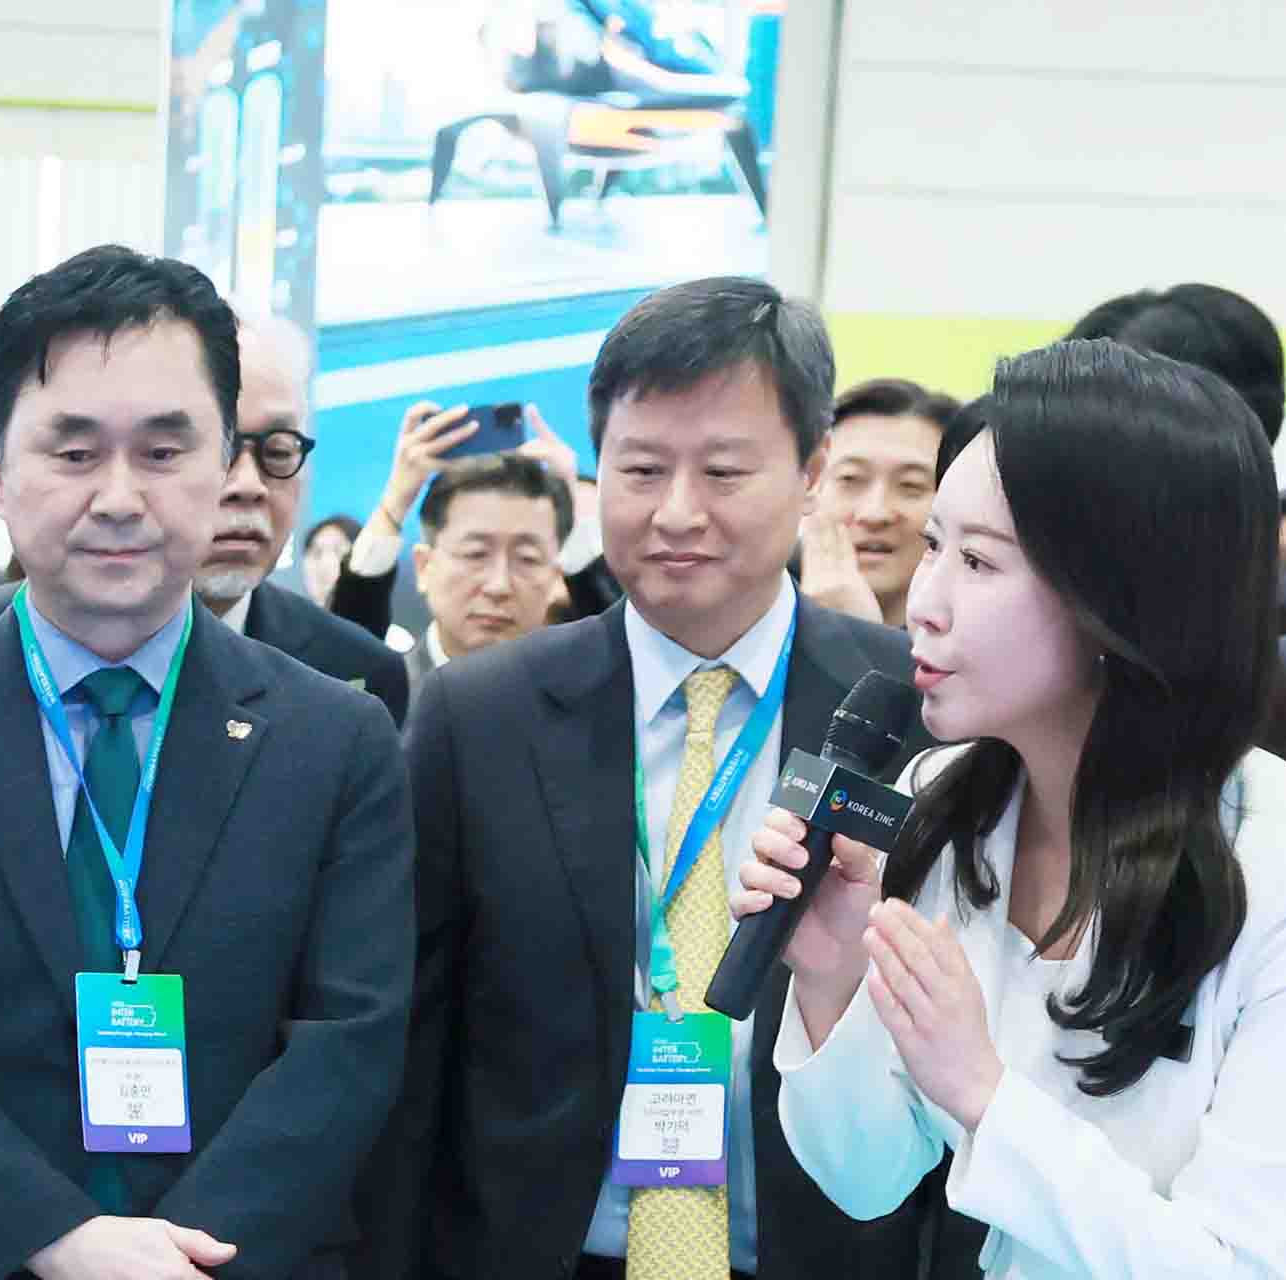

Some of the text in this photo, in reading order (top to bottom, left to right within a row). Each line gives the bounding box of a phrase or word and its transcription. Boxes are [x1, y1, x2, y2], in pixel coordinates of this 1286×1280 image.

[846, 800, 896, 827] KOREA ZINC
[127, 1131, 149, 1145] VIP
[659, 1166, 682, 1179] VIP
